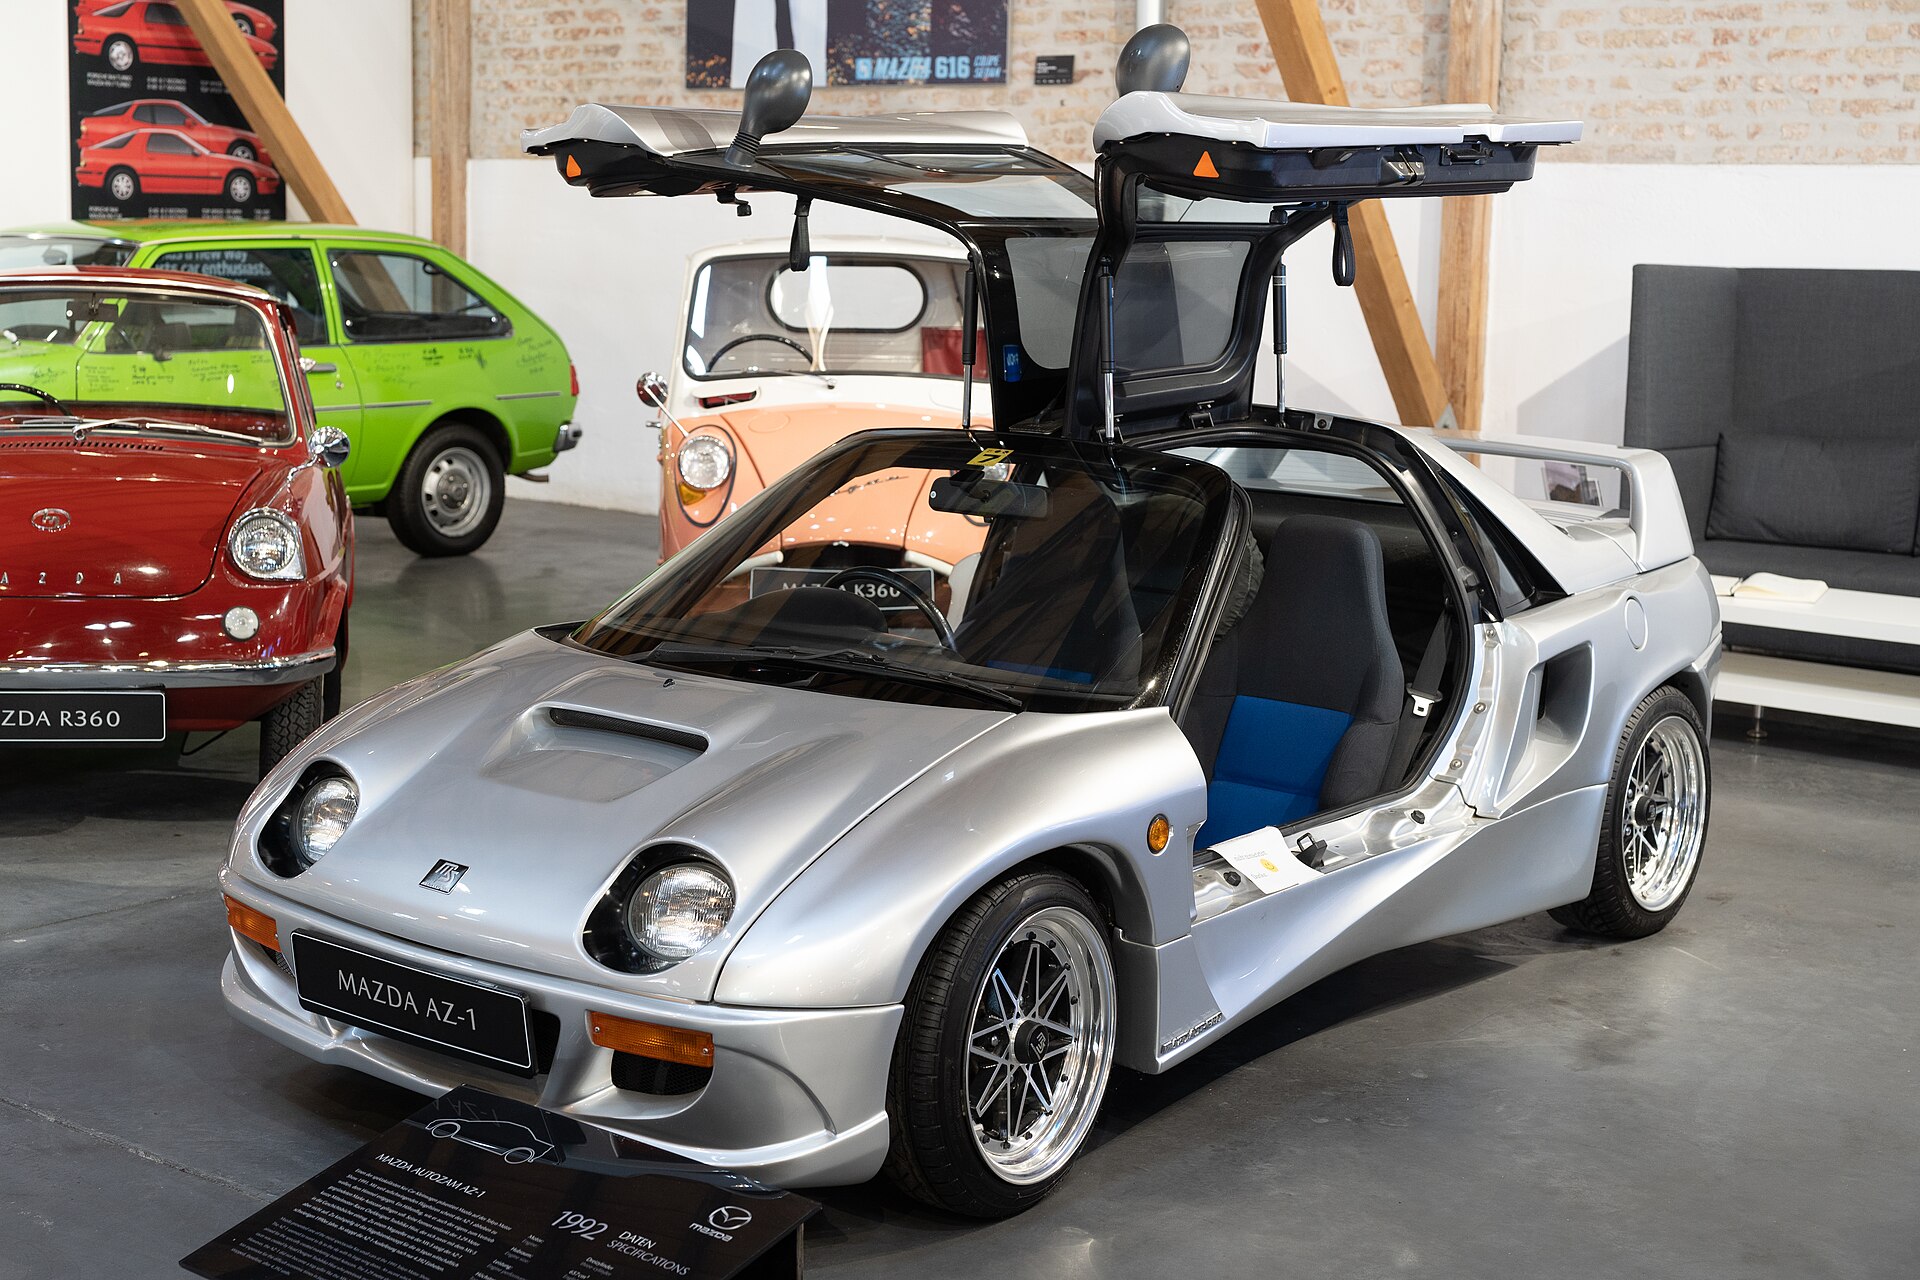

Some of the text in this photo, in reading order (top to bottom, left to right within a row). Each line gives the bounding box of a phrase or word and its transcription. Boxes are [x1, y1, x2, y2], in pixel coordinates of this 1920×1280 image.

[873, 55, 970, 80] MAZDA 616
[224, 250, 248, 263] way
[60, 710, 121, 727] R360
[338, 969, 476, 1031] MAZDA AZ-1
[375, 1153, 487, 1198] MAZDA AUTOZAM AZ-1
[551, 1211, 608, 1241] 1992
[618, 1230, 657, 1250] DATEN
[606, 1240, 691, 1276] SPECIFICATIONS
